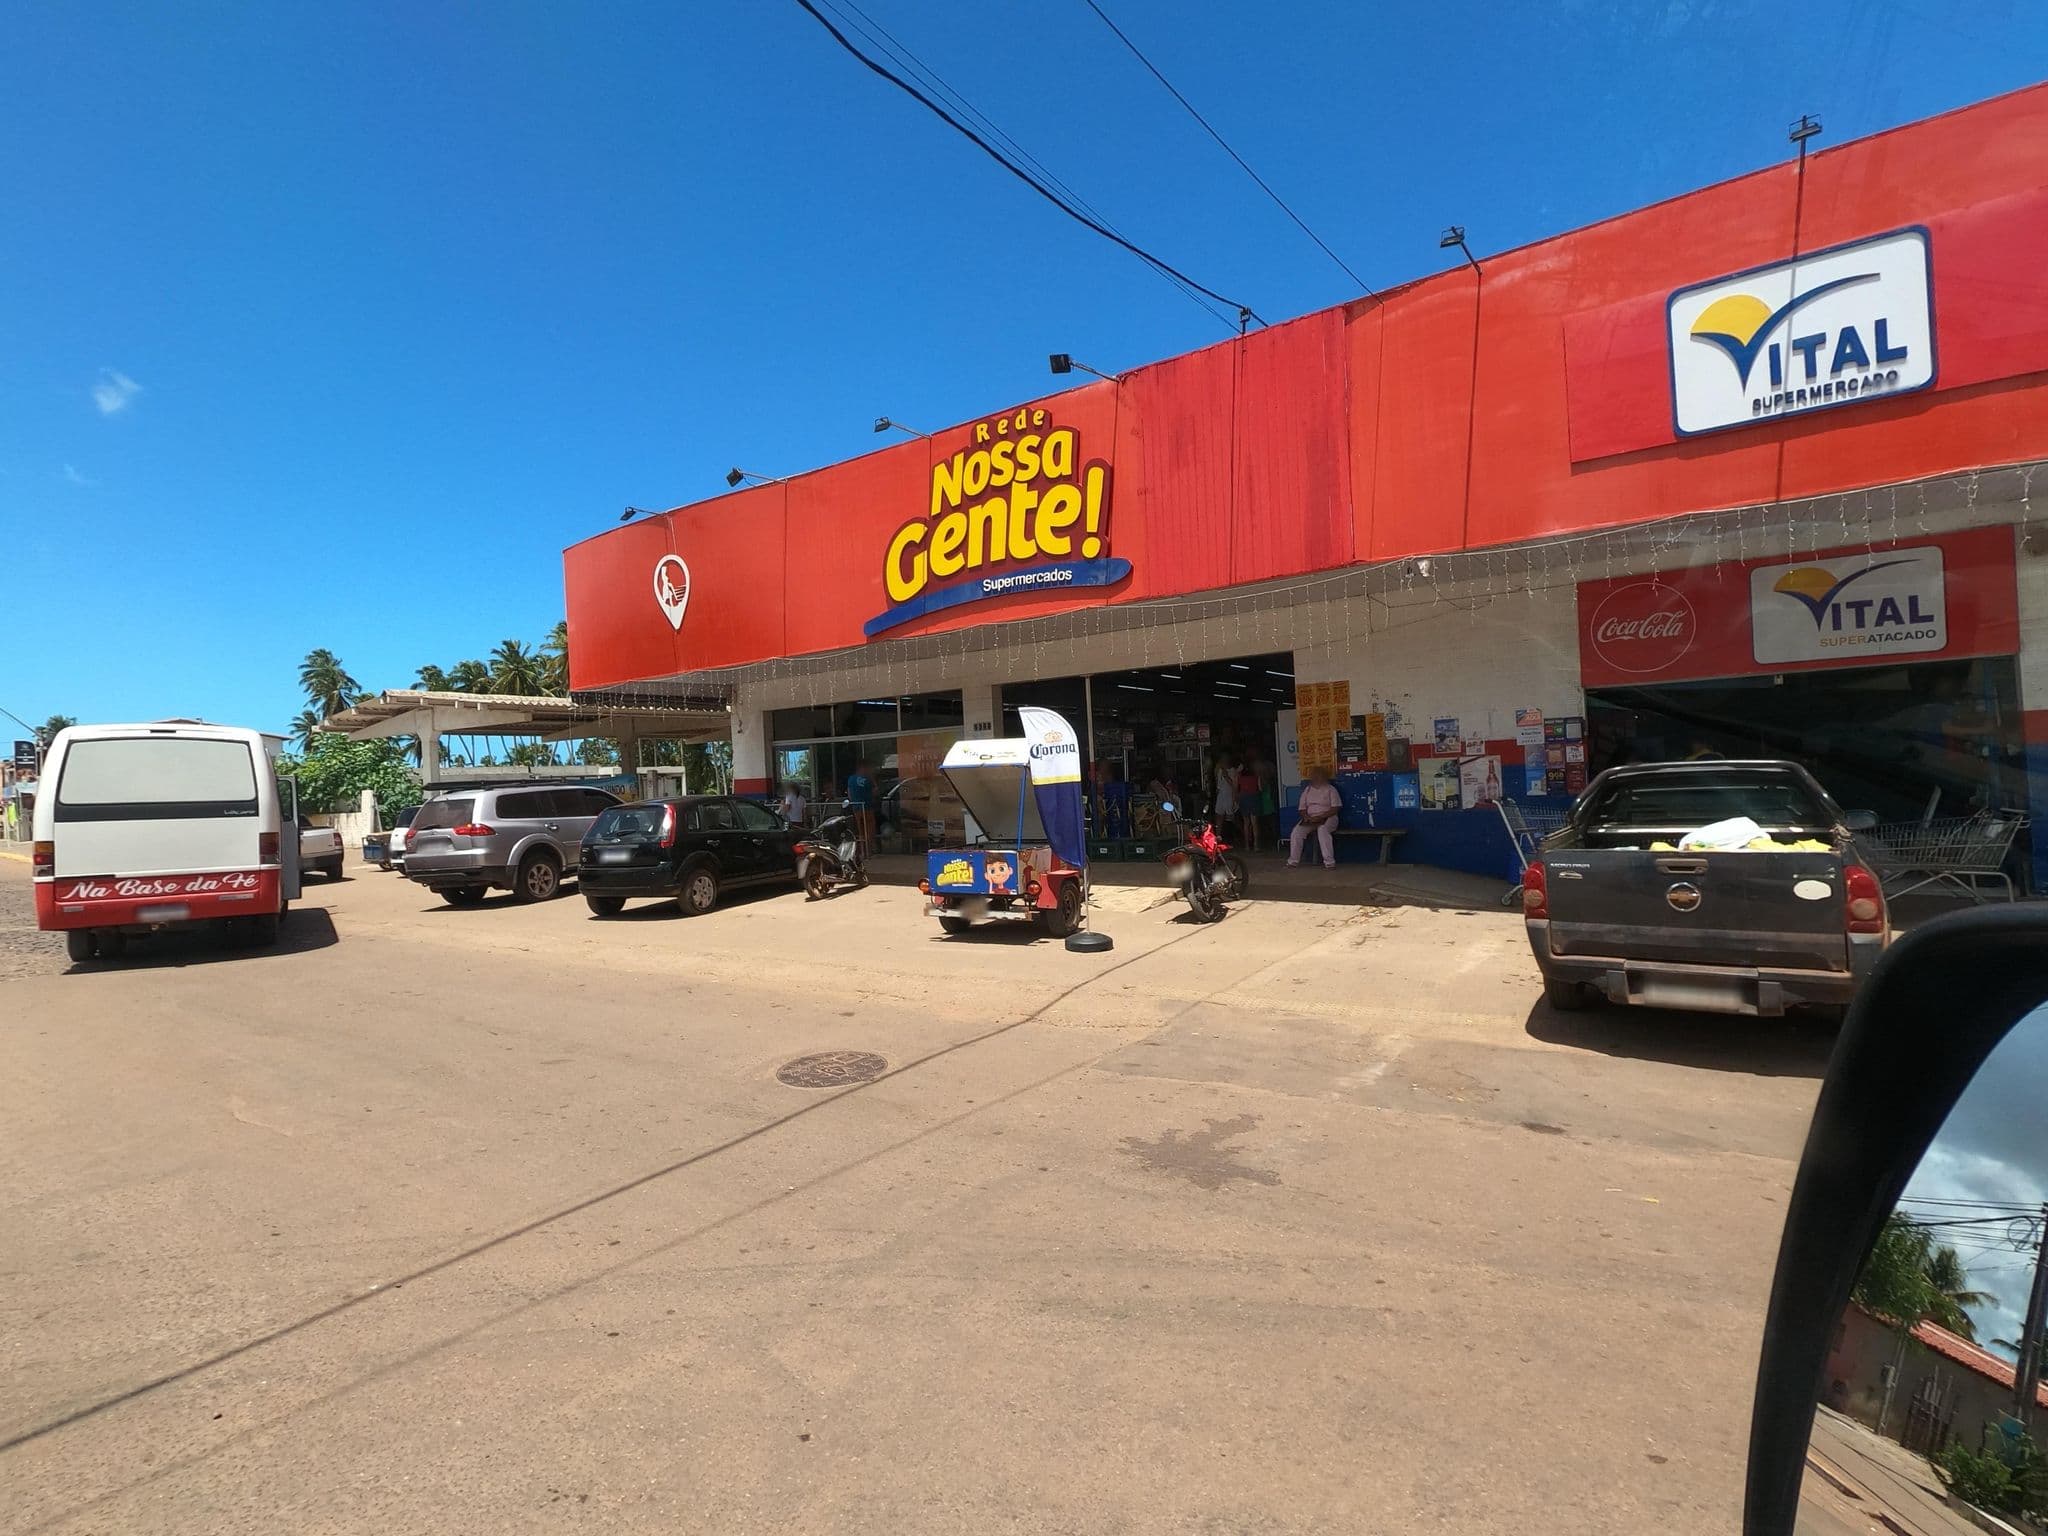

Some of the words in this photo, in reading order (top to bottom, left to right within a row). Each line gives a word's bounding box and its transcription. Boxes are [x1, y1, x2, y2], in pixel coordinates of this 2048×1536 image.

[1690, 272, 1908, 398] VITAL
[1752, 370, 1899, 411] SUPERMERCADO
[976, 408, 1046, 443] Rede
[931, 430, 1073, 517] Nossa
[886, 466, 1105, 602] Gente!
[982, 568, 1073, 592] Supermercados
[1773, 558, 1934, 632] VITAL
[1597, 610, 1688, 643] Coca-Cola
[1819, 628, 1938, 648] SUPERATACADO
[1030, 743, 1076, 759] Corona
[63, 881, 112, 899] Na
[185, 876, 222, 892] da
[222, 872, 259, 889] Fé
